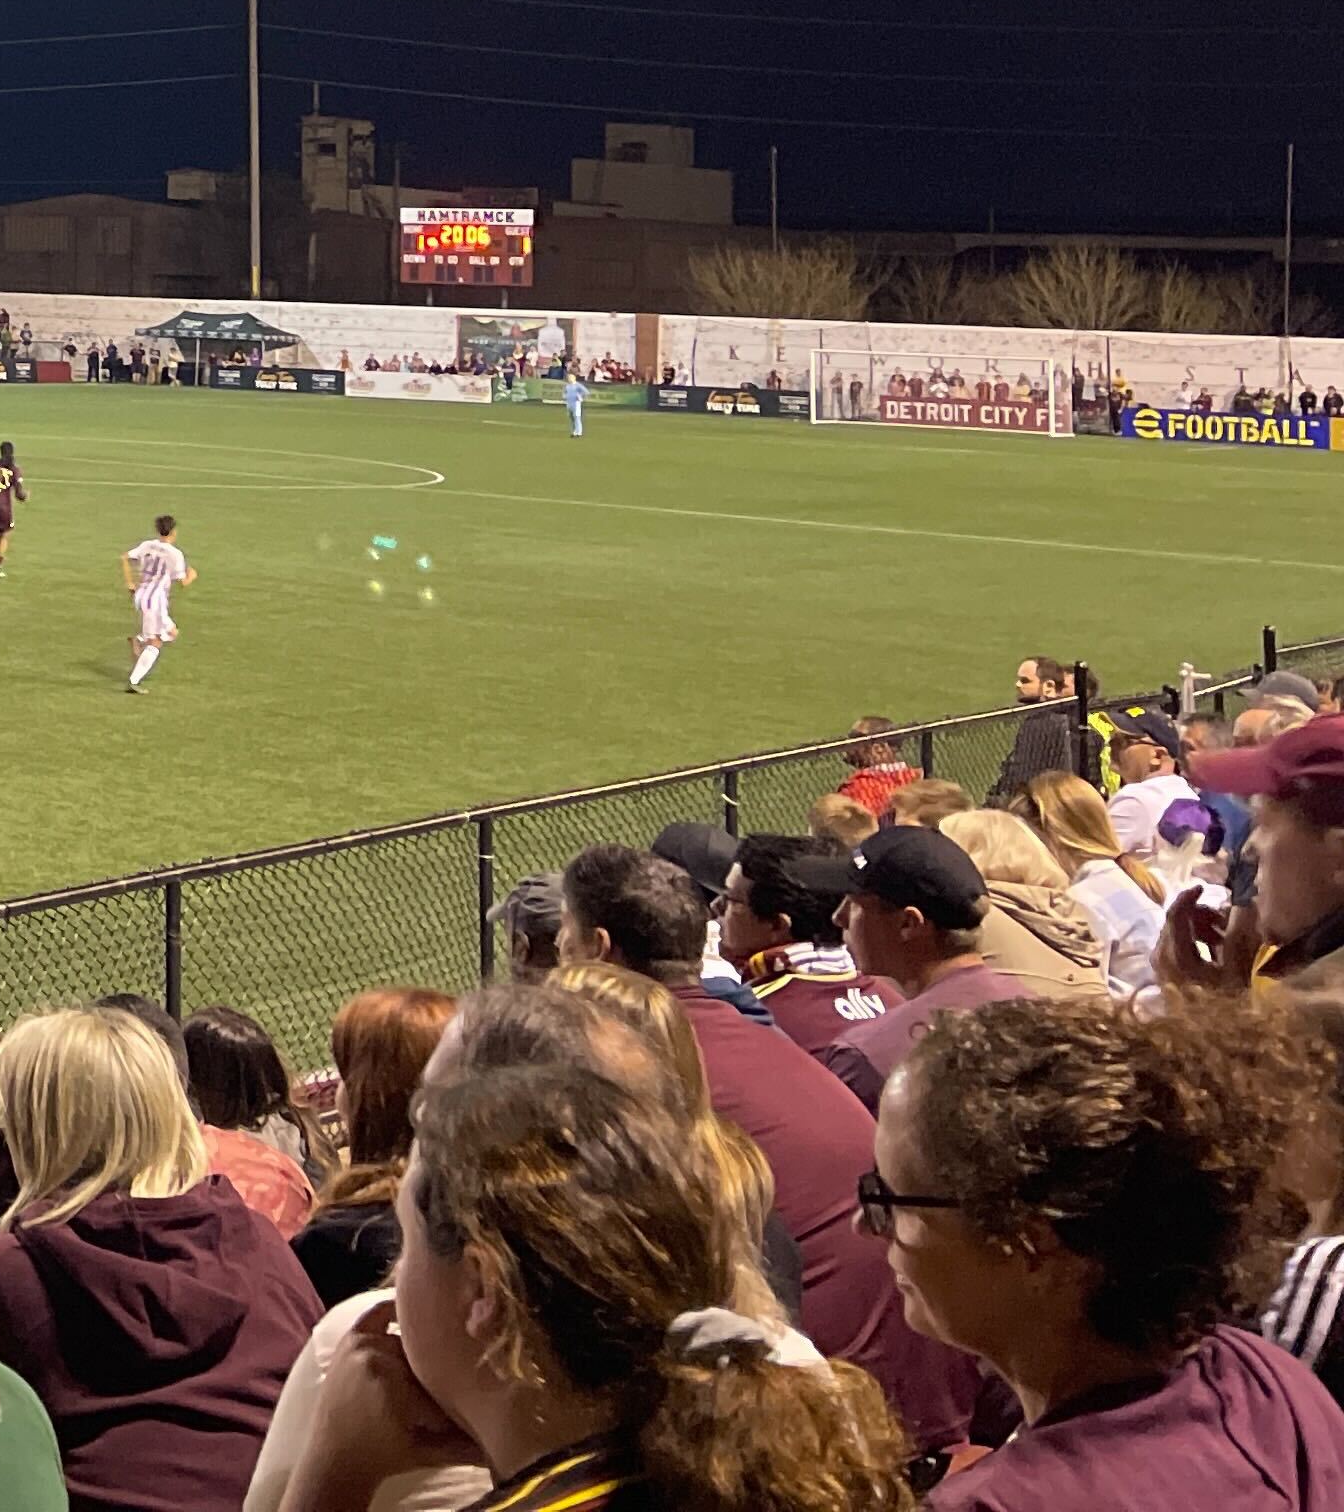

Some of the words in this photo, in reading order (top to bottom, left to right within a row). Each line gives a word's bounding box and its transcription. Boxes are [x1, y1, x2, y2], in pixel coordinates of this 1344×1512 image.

[417, 209, 515, 223] HAMTRAMCK
[885, 400, 973, 423] DETROIT
[979, 405, 1029, 426] CITY
